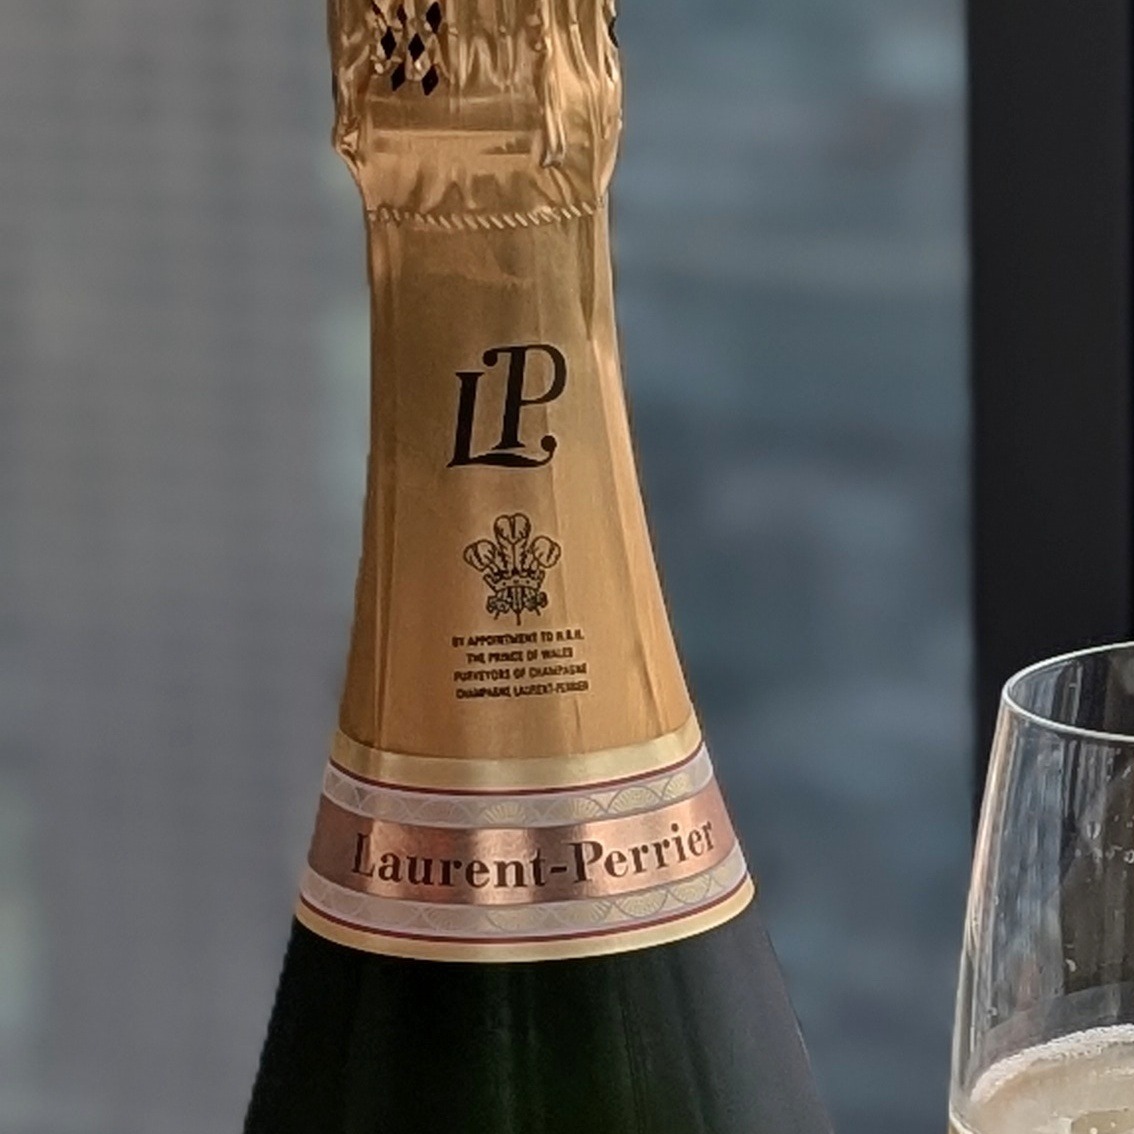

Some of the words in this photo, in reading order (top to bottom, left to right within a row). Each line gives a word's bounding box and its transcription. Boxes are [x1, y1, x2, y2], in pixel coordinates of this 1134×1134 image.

[541, 631, 553, 642] TO
[466, 653, 485, 664] THE
[488, 652, 523, 663] PRINCE
[541, 647, 573, 660] WALES
[454, 669, 510, 682] PURVEYORS
[513, 667, 525, 679] OF
[529, 663, 587, 678] CHAMPAGNE
[456, 687, 511, 699] CHAMPAGNE
[513, 681, 589, 697] LAURENT-PERRIER
[351, 822, 716, 889] Laurent-Perrier
